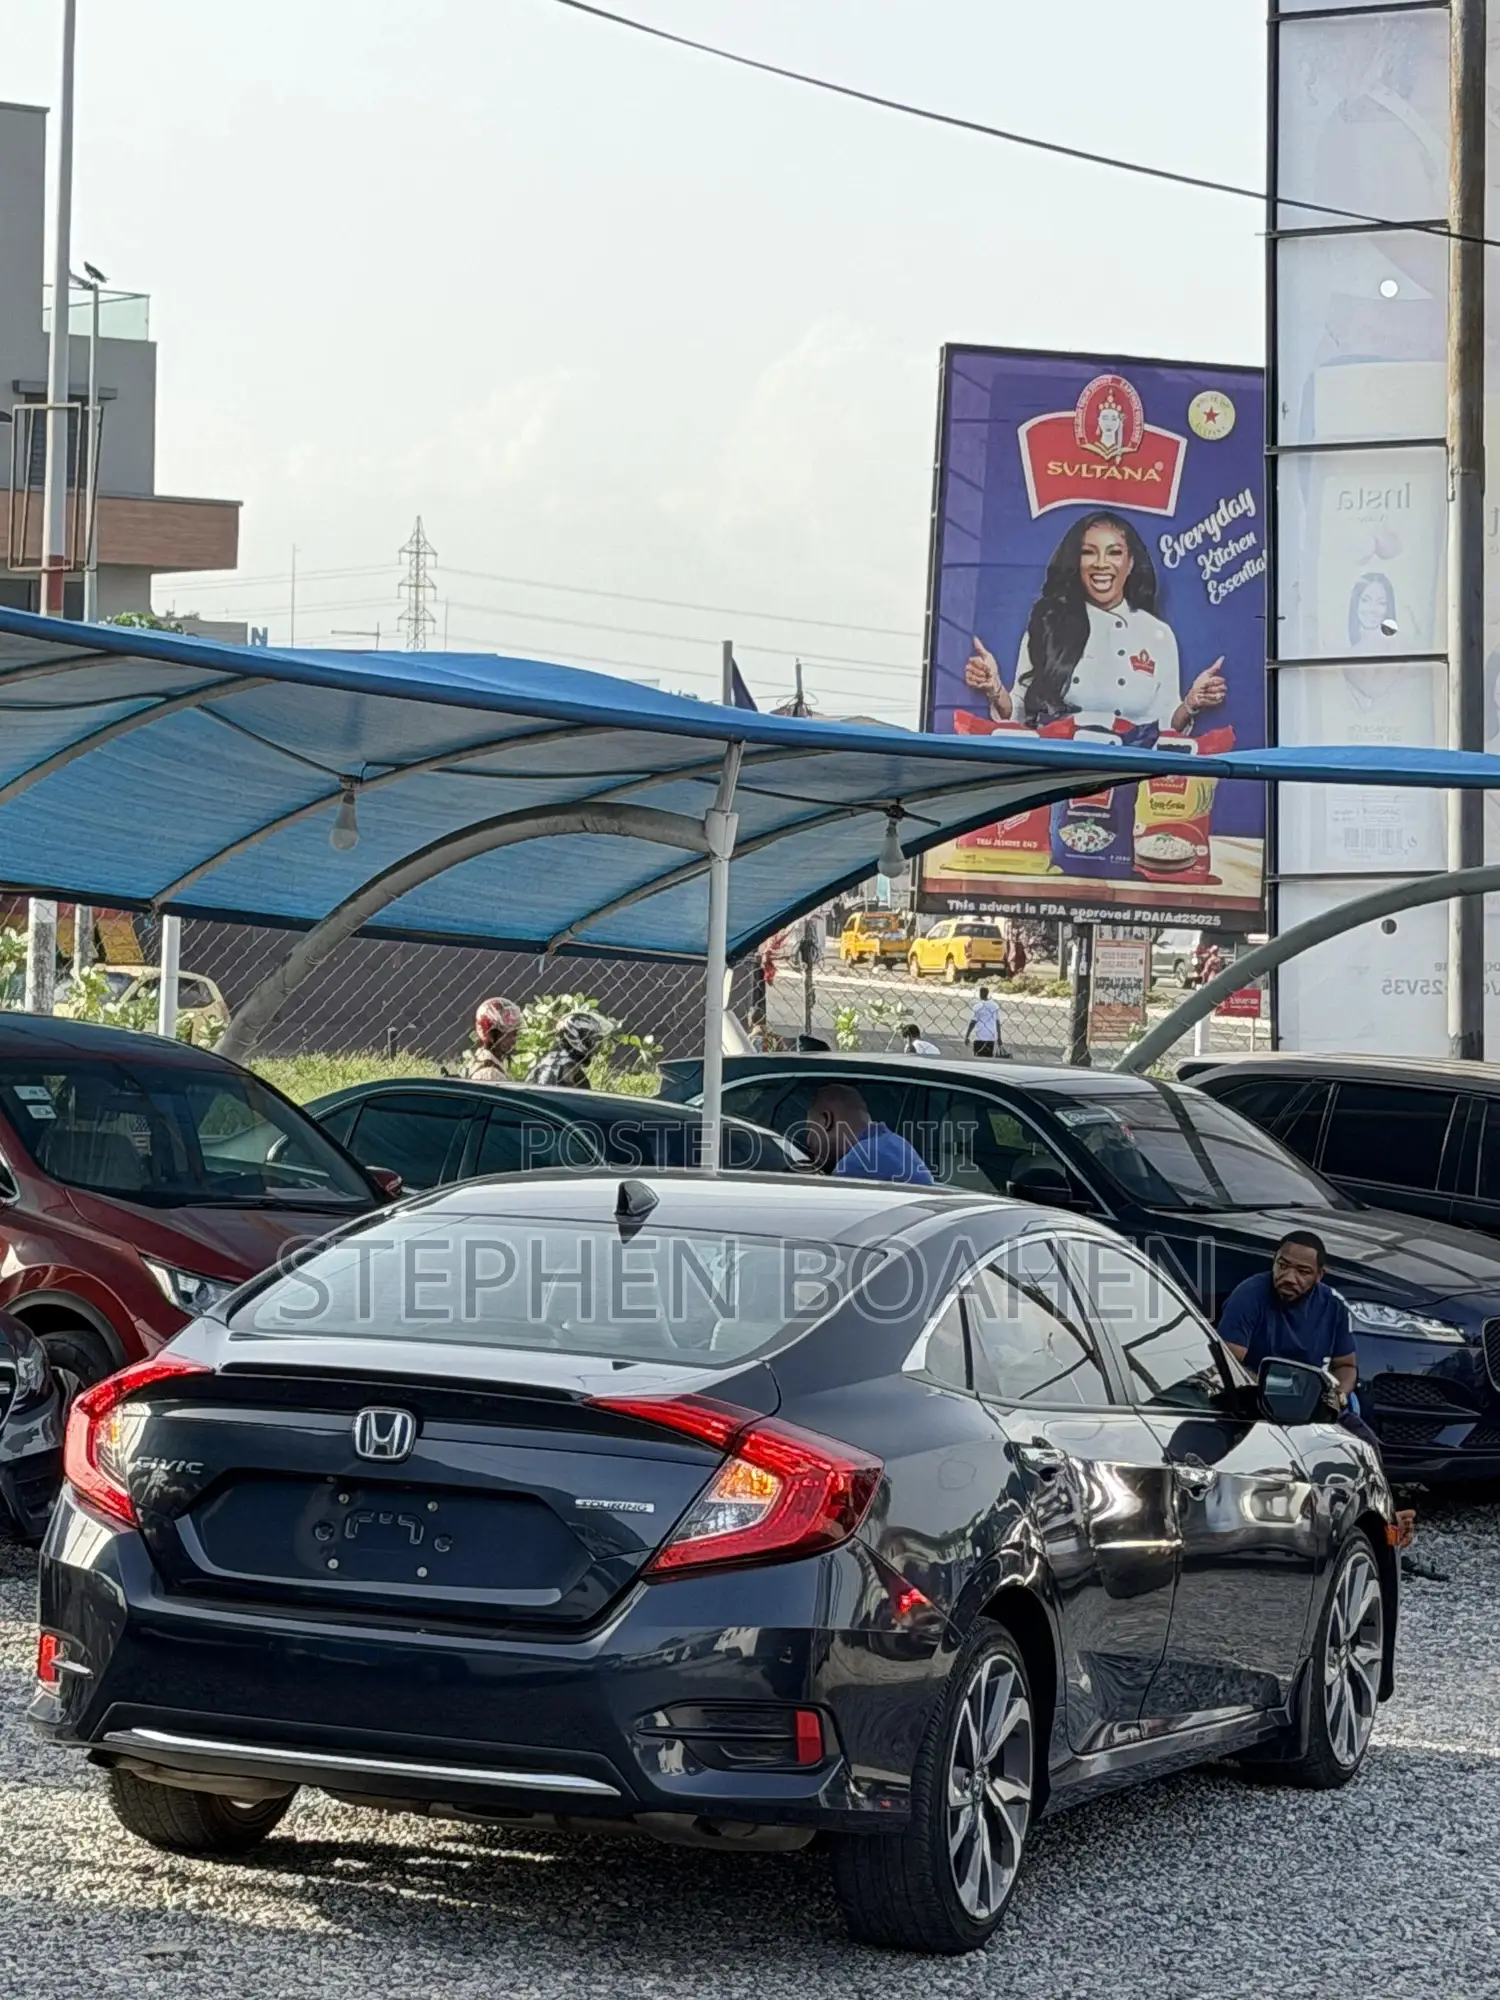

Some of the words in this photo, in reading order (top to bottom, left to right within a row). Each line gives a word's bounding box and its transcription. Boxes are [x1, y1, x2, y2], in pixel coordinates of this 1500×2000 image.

[1160, 488, 1256, 568] Everyday
[1197, 531, 1257, 580] Kitchen
[947, 899, 975, 911] This
[979, 901, 1021, 914] advert
[1025, 903, 1036, 914] is
[1040, 904, 1066, 915] FDA
[1070, 908, 1131, 920] approved
[136, 1456, 204, 1474] CIVIC
